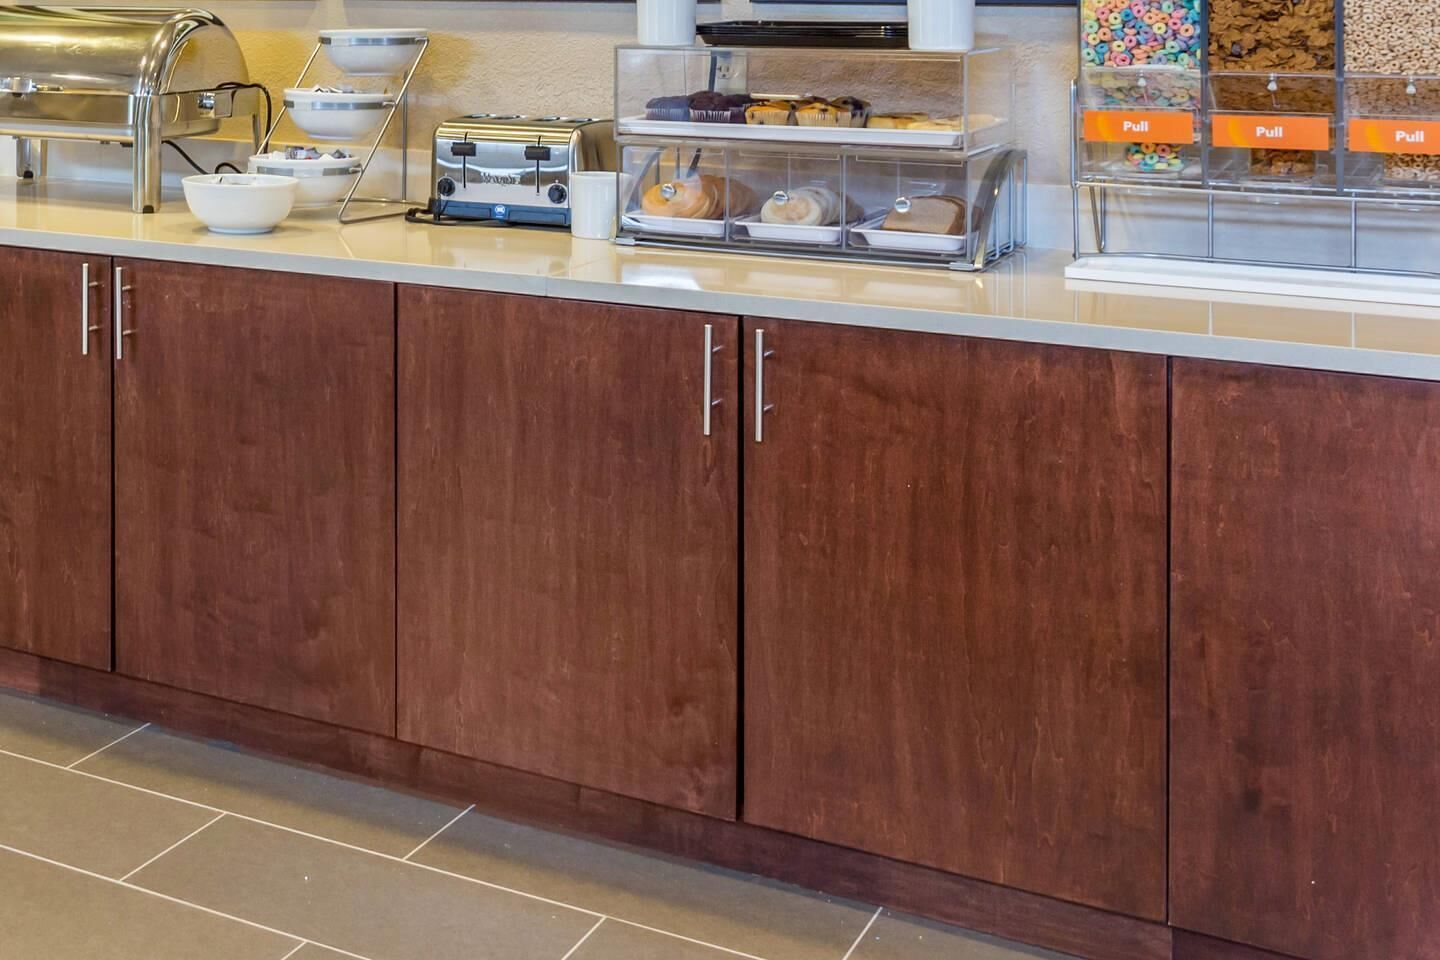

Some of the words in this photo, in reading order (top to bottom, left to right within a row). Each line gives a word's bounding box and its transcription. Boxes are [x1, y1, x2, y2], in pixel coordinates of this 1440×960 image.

[1123, 121, 1149, 132] Pull
[1255, 126, 1283, 138] Pull
[1395, 130, 1425, 142] Pull
